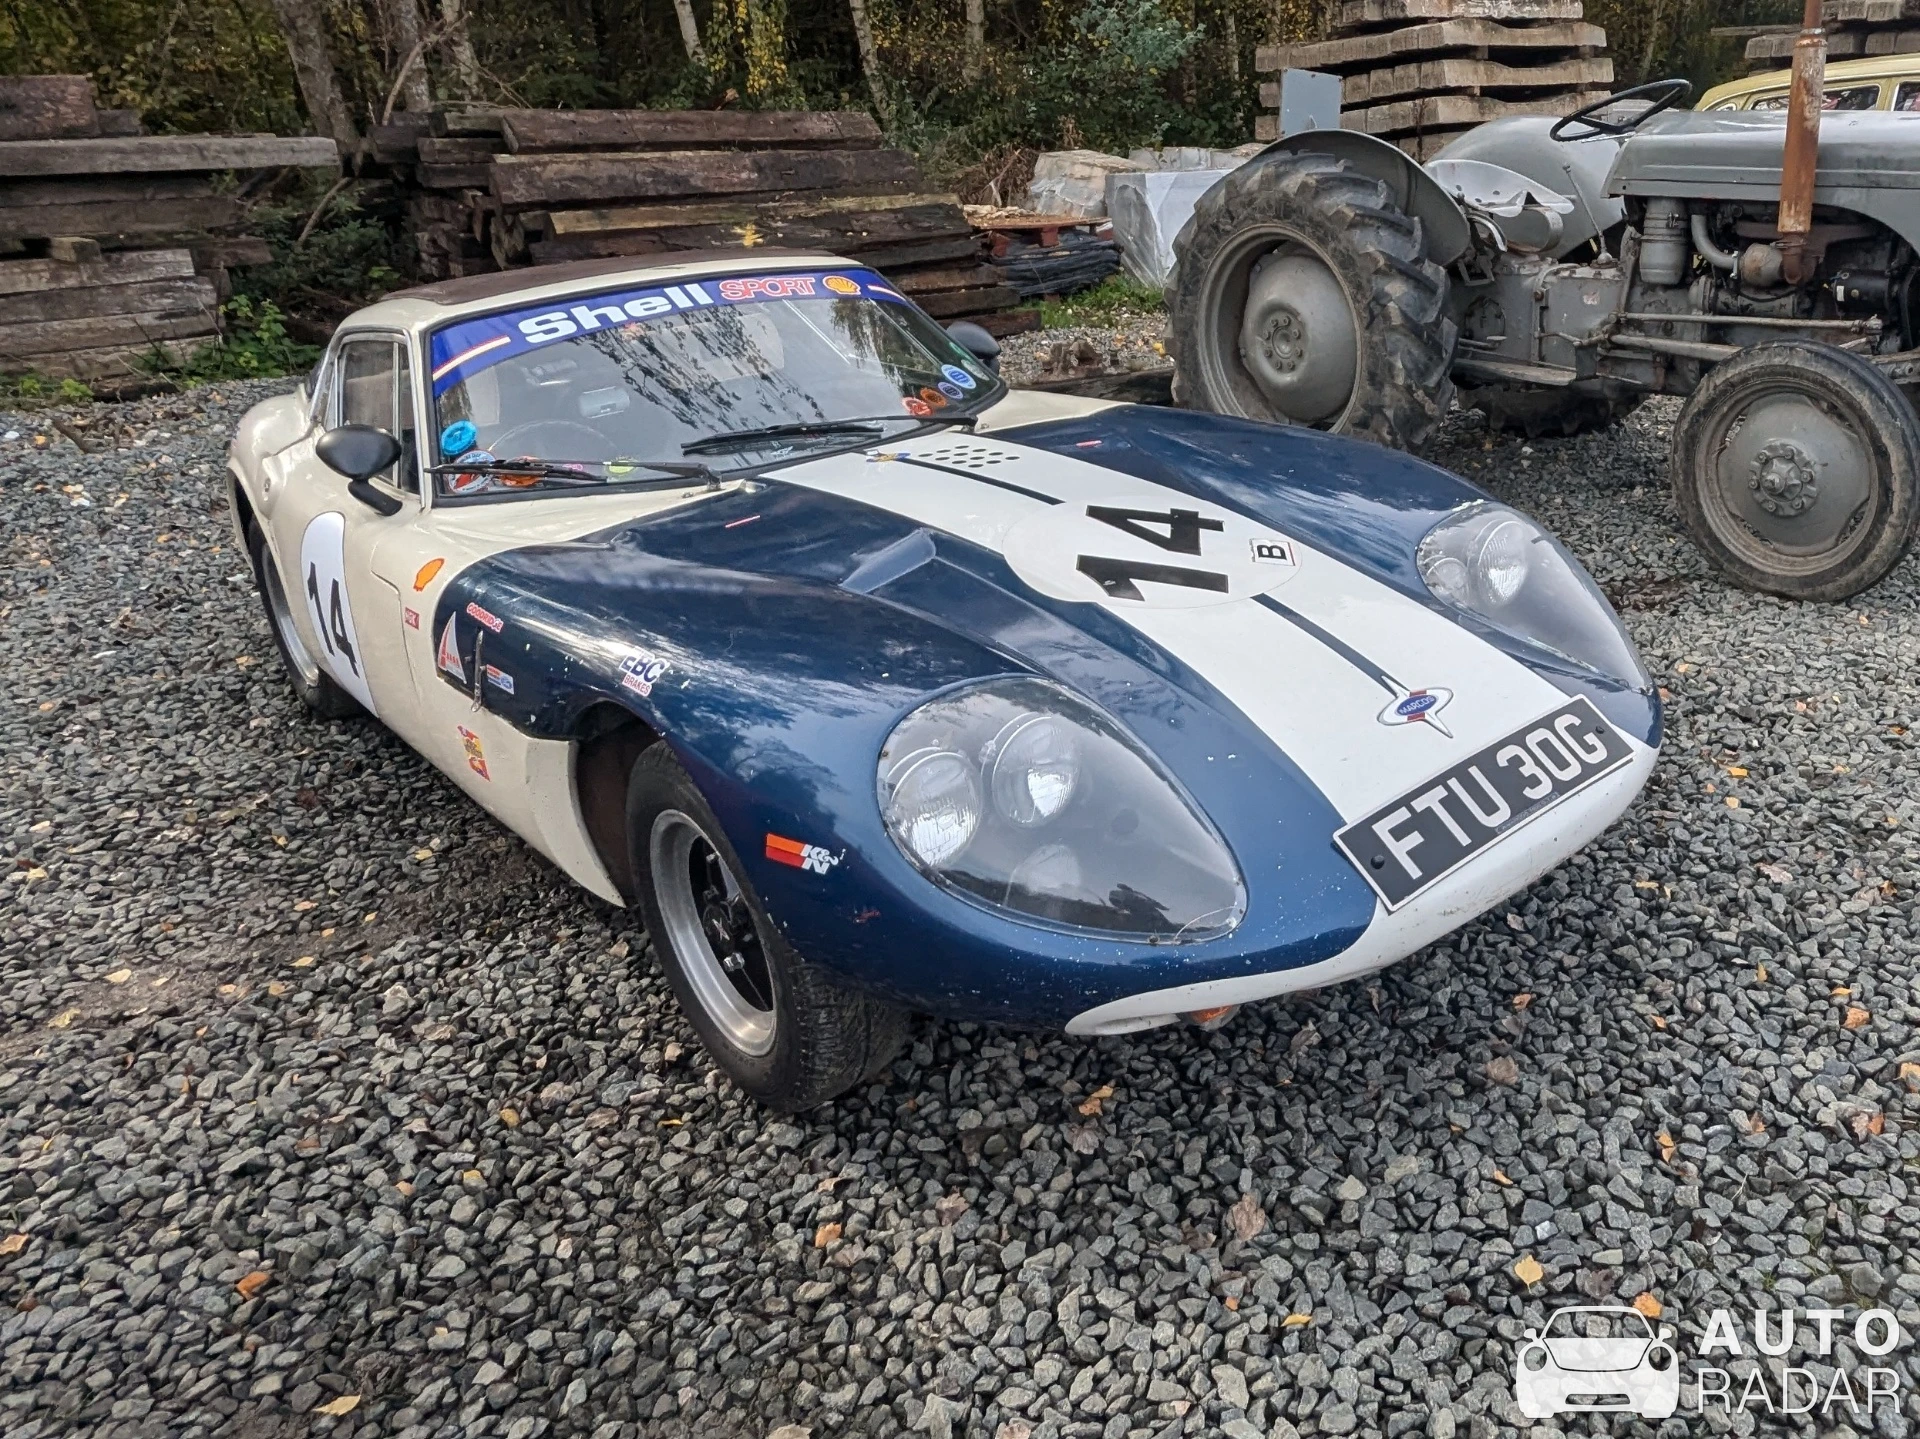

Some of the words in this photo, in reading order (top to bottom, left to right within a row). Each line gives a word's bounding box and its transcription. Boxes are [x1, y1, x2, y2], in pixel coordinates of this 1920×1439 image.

[517, 283, 715, 344] Shell
[718, 277, 816, 300] SPORT
[1075, 505, 1229, 602] 14
[1256, 543, 1288, 560] B
[307, 560, 360, 679] 14
[620, 652, 666, 683] EBC
[624, 674, 651, 695] BRAKES
[1398, 695, 1435, 714] MARCOS
[1371, 765, 1512, 880] FTU
[1496, 713, 1608, 800] 30G
